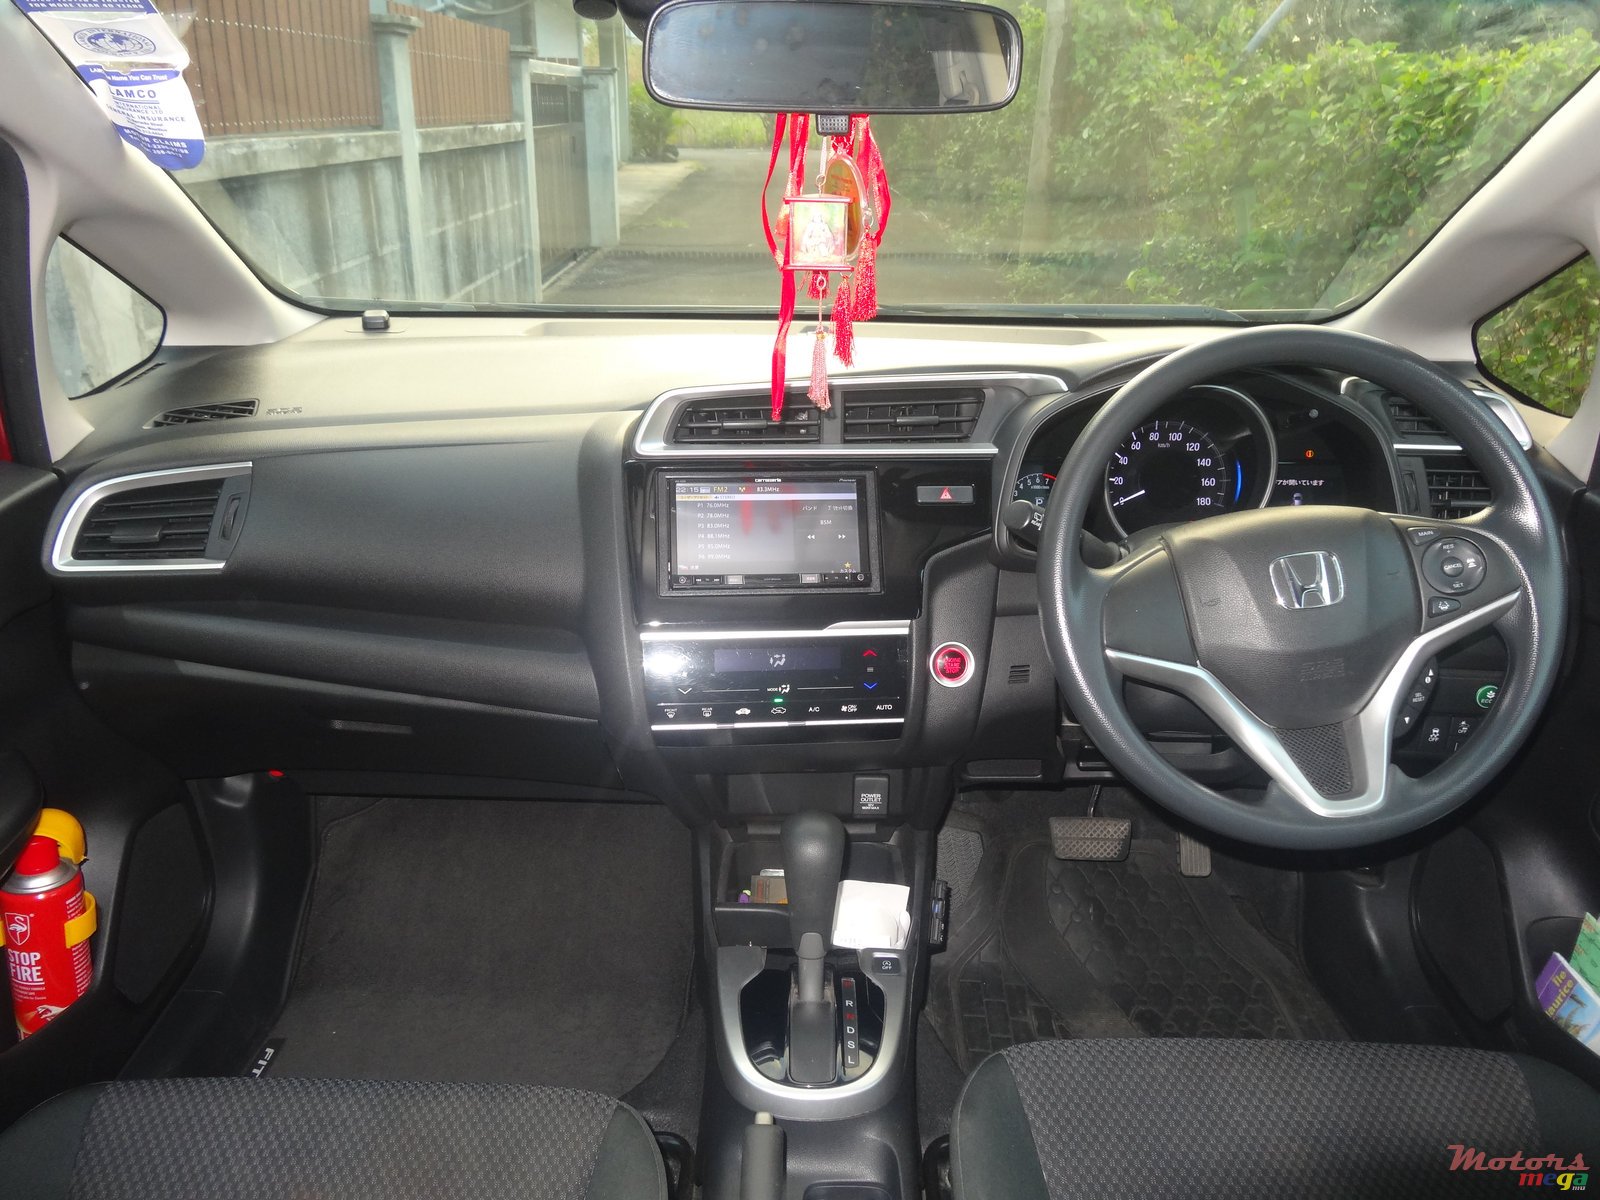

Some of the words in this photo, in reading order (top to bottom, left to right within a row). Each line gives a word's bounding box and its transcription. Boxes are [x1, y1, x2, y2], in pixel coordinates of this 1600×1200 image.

[152, 138, 188, 149] CLAIMS
[1149, 432, 1160, 441] 80
[1169, 432, 1183, 441] 100
[1131, 441, 1141, 450] 60
[1186, 442, 1200, 451] 120
[1119, 456, 1128, 465] 40
[1197, 458, 1212, 467] 140
[1114, 476, 1124, 485] 20
[1201, 478, 1216, 487] 160
[1197, 497, 1211, 506] 180
[1443, 562, 1463, 570] CANCEL
[8, 948, 41, 966] STOP
[10, 963, 44, 982] FIRE
[846, 1026, 855, 1034] D
[847, 1040, 856, 1049] S
[251, 1047, 275, 1078] FIT
[847, 1055, 855, 1065] L
